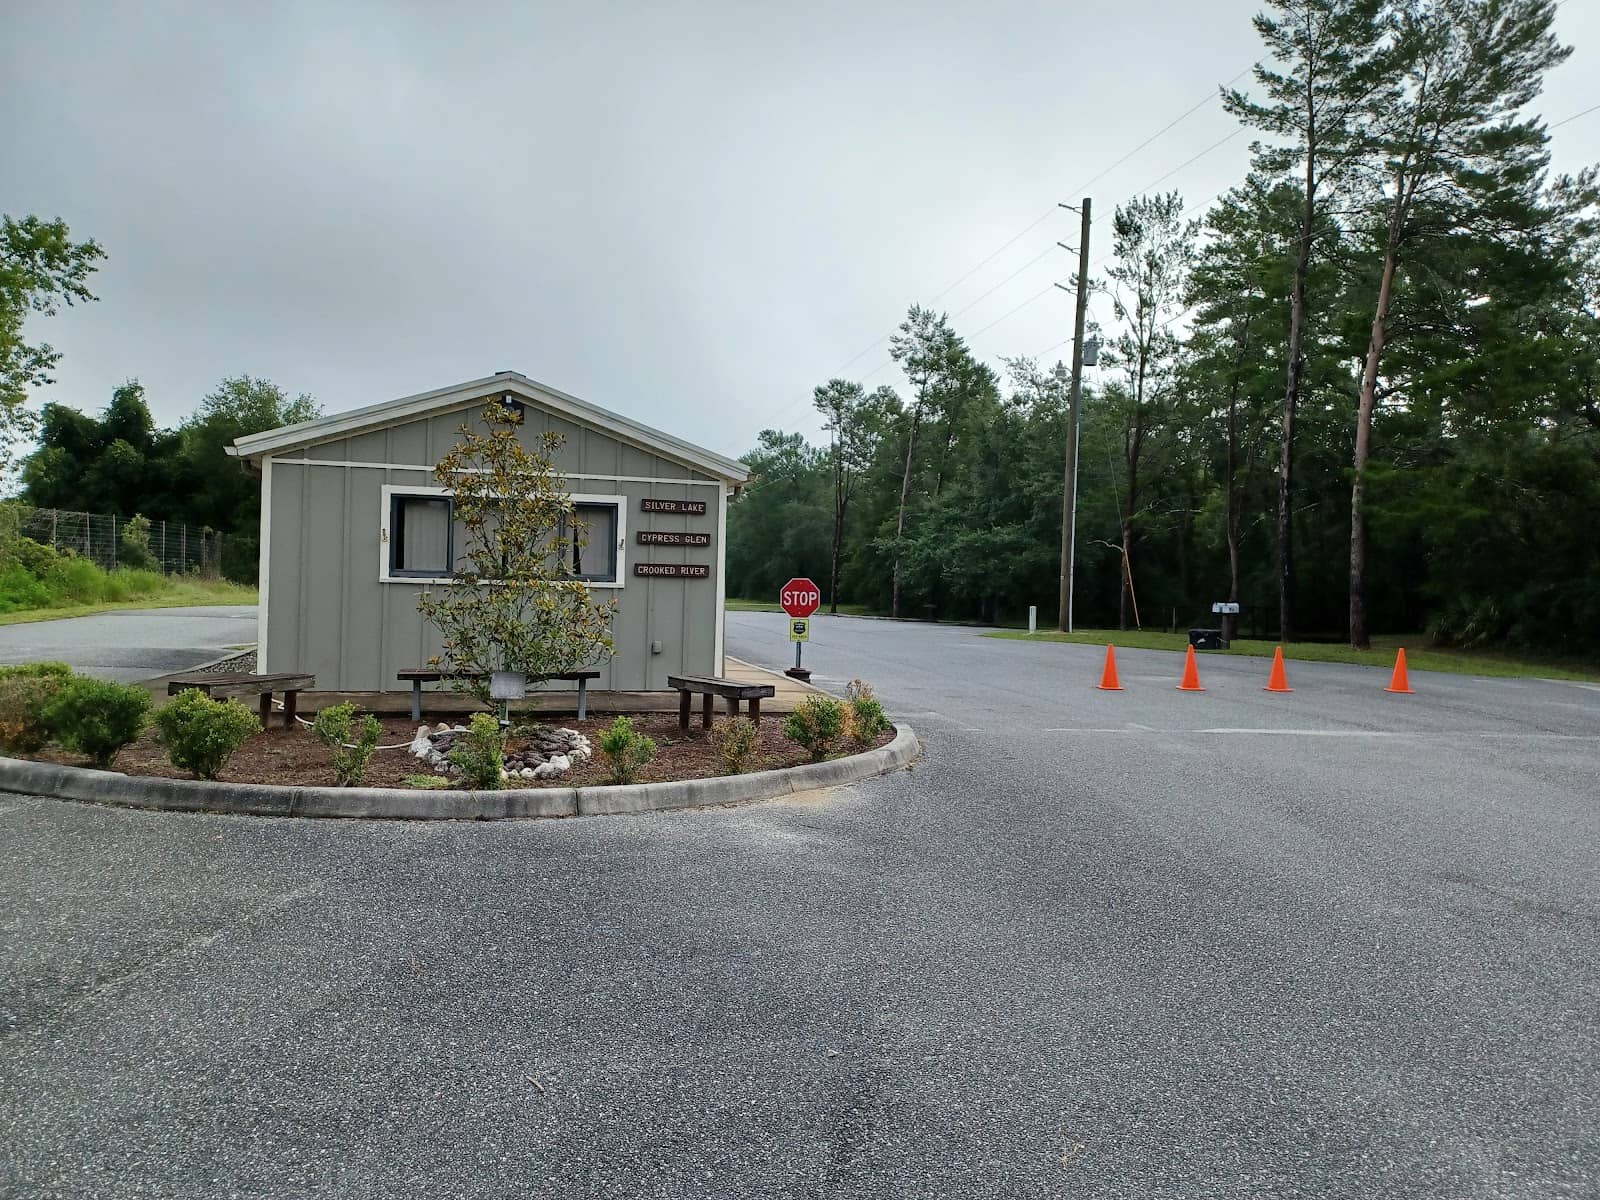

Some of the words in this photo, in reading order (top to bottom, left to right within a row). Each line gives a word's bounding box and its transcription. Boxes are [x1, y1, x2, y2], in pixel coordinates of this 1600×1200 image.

[644, 501, 676, 511] SILVER
[681, 503, 704, 512] LAKE
[641, 534, 680, 543] CYPRESS
[684, 535, 707, 544] GLEN
[637, 566, 676, 575] CROOKED
[680, 566, 705, 575] RIVER
[783, 591, 817, 606] STOP
